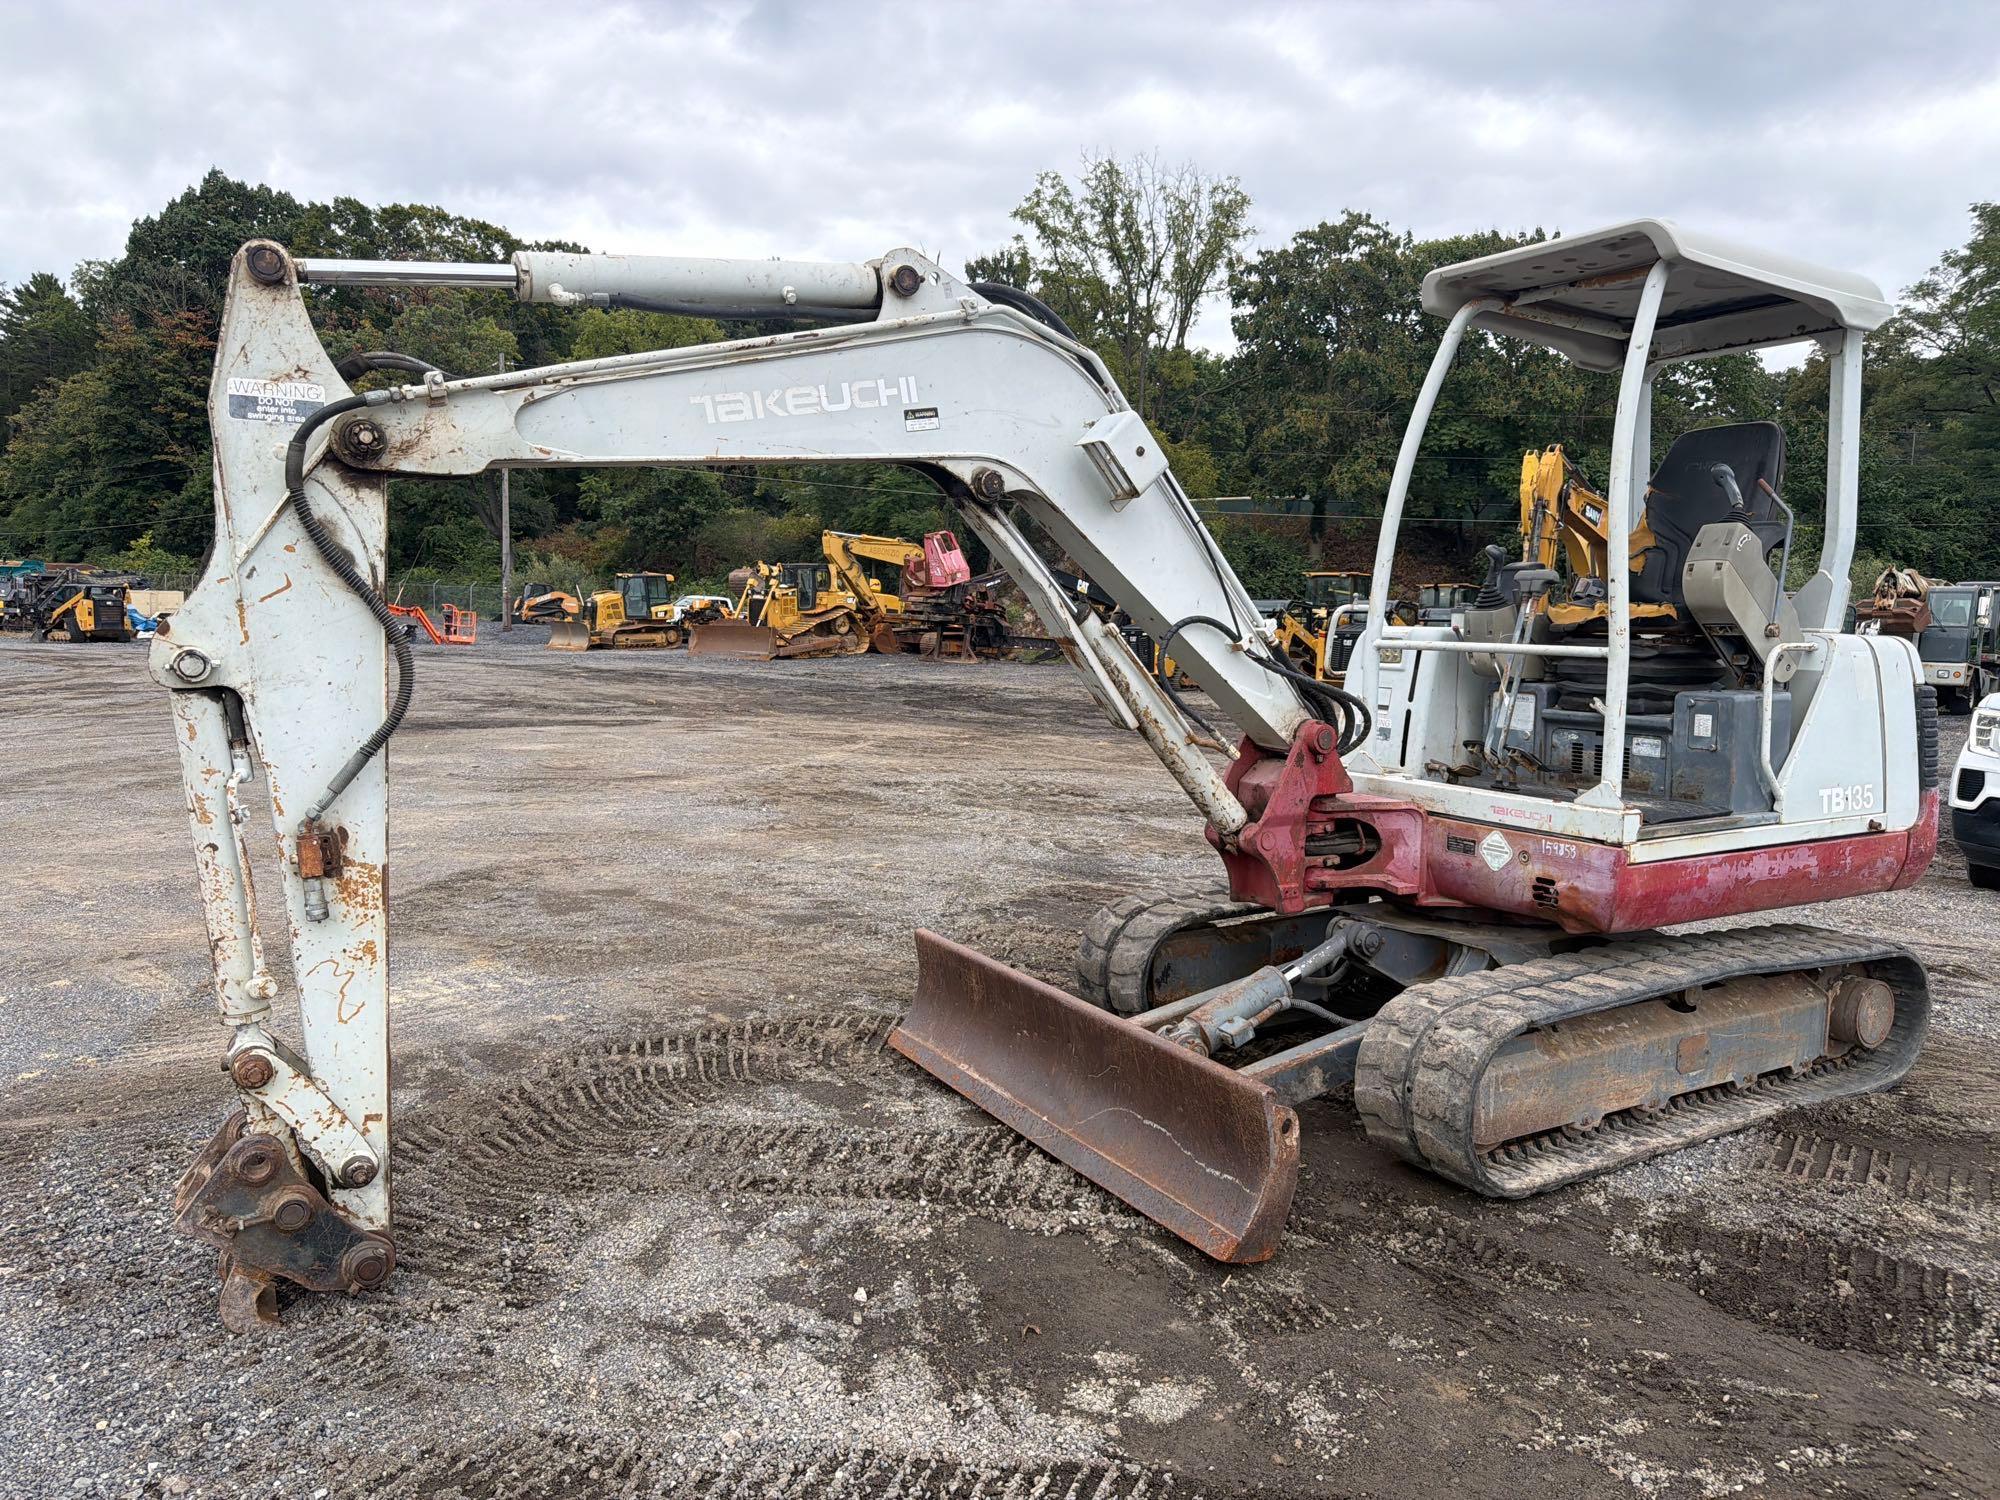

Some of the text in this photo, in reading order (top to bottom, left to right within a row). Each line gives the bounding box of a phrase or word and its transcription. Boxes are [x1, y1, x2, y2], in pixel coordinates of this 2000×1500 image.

[234, 380, 320, 399] WARNING
[258, 397, 295, 407] DO NOT
[256, 405, 297, 415] enter into
[247, 411, 306, 423] swinging area
[1818, 784, 1874, 814] TB135
